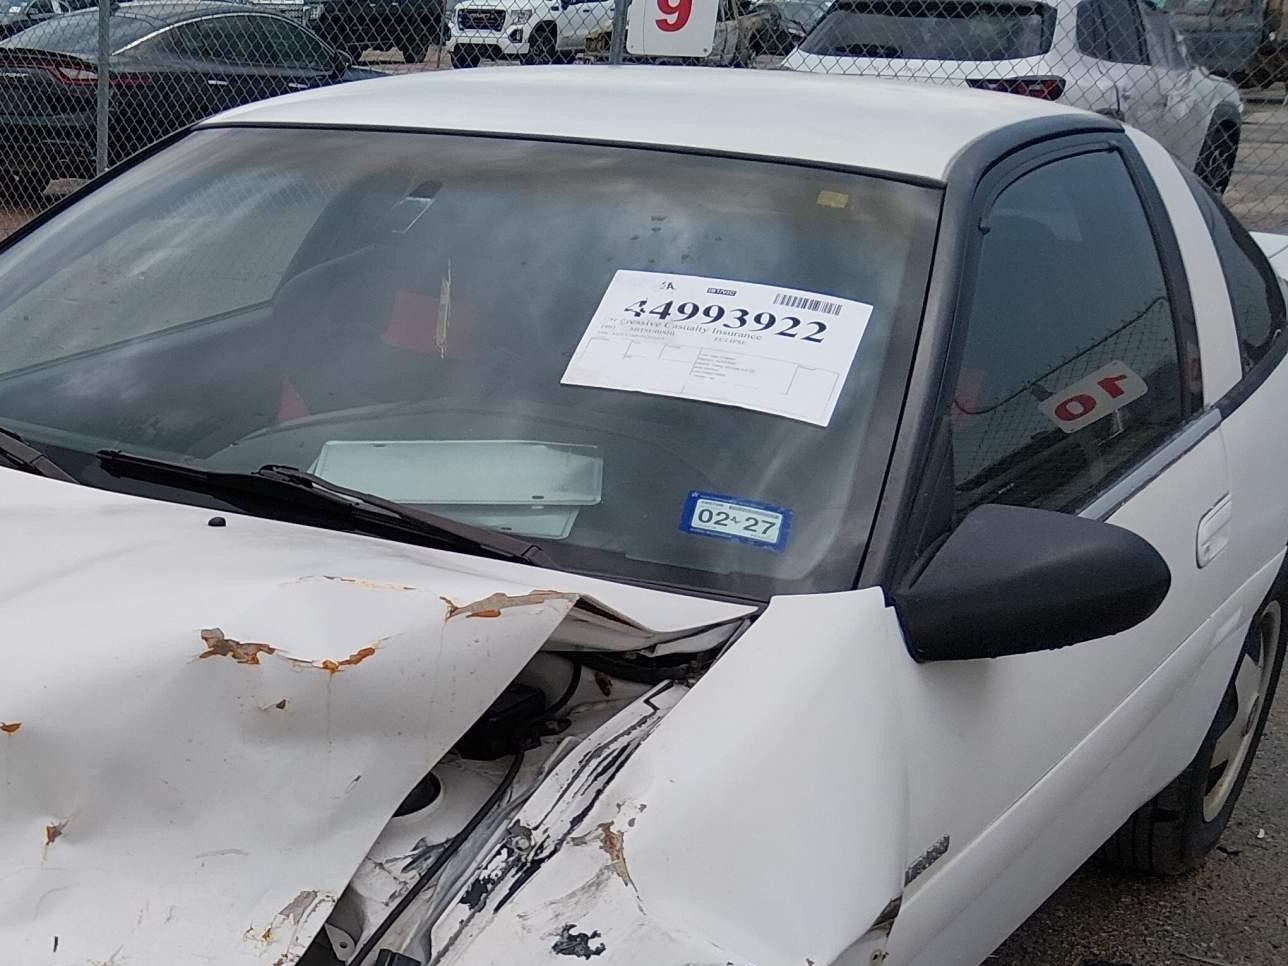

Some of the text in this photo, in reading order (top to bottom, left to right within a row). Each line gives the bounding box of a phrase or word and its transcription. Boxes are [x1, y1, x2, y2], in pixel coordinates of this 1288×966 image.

[655, 0, 693, 33] 9
[623, 297, 828, 344] 44993922
[663, 319, 707, 334] Casualty
[711, 326, 763, 341] Insurance
[698, 508, 730, 527] 02
[743, 516, 776, 536] 27
